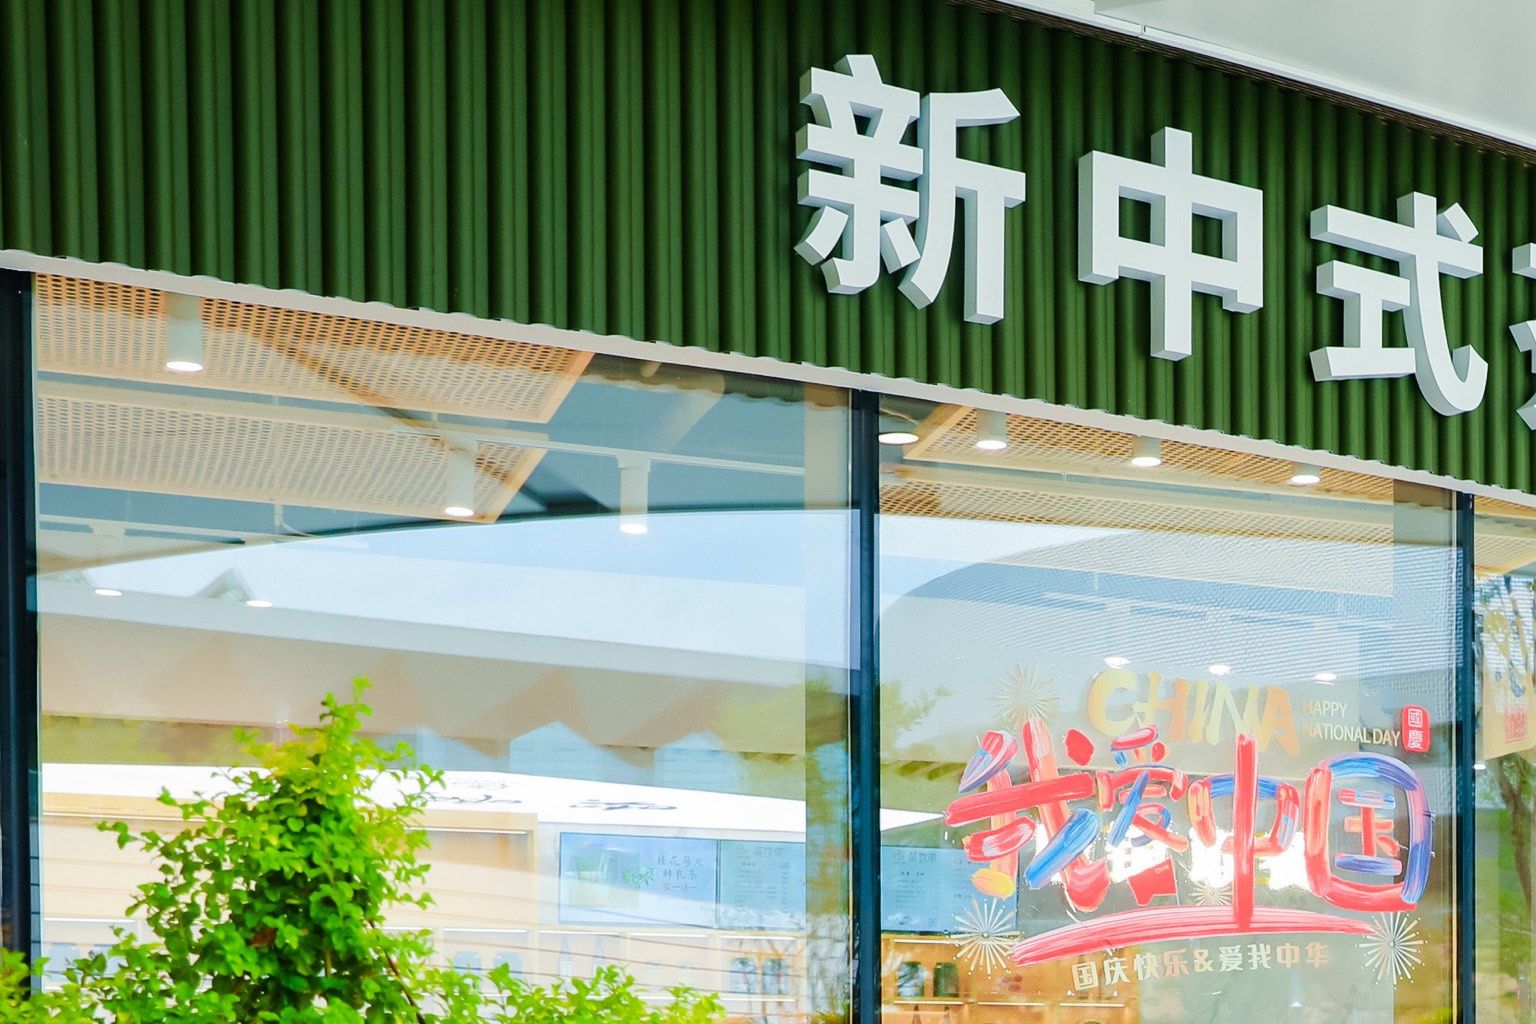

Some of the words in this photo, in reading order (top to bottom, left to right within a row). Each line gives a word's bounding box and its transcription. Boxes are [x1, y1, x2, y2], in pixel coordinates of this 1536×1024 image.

[1087, 670, 1300, 756] CHINA
[1302, 698, 1348, 718] HAPPY
[1302, 722, 1372, 743] NATIONAL
[1373, 727, 1401, 747] DAY
[944, 717, 1432, 930] 我爱中国
[1072, 942, 1328, 991] 国庆快乐&爱我中华
